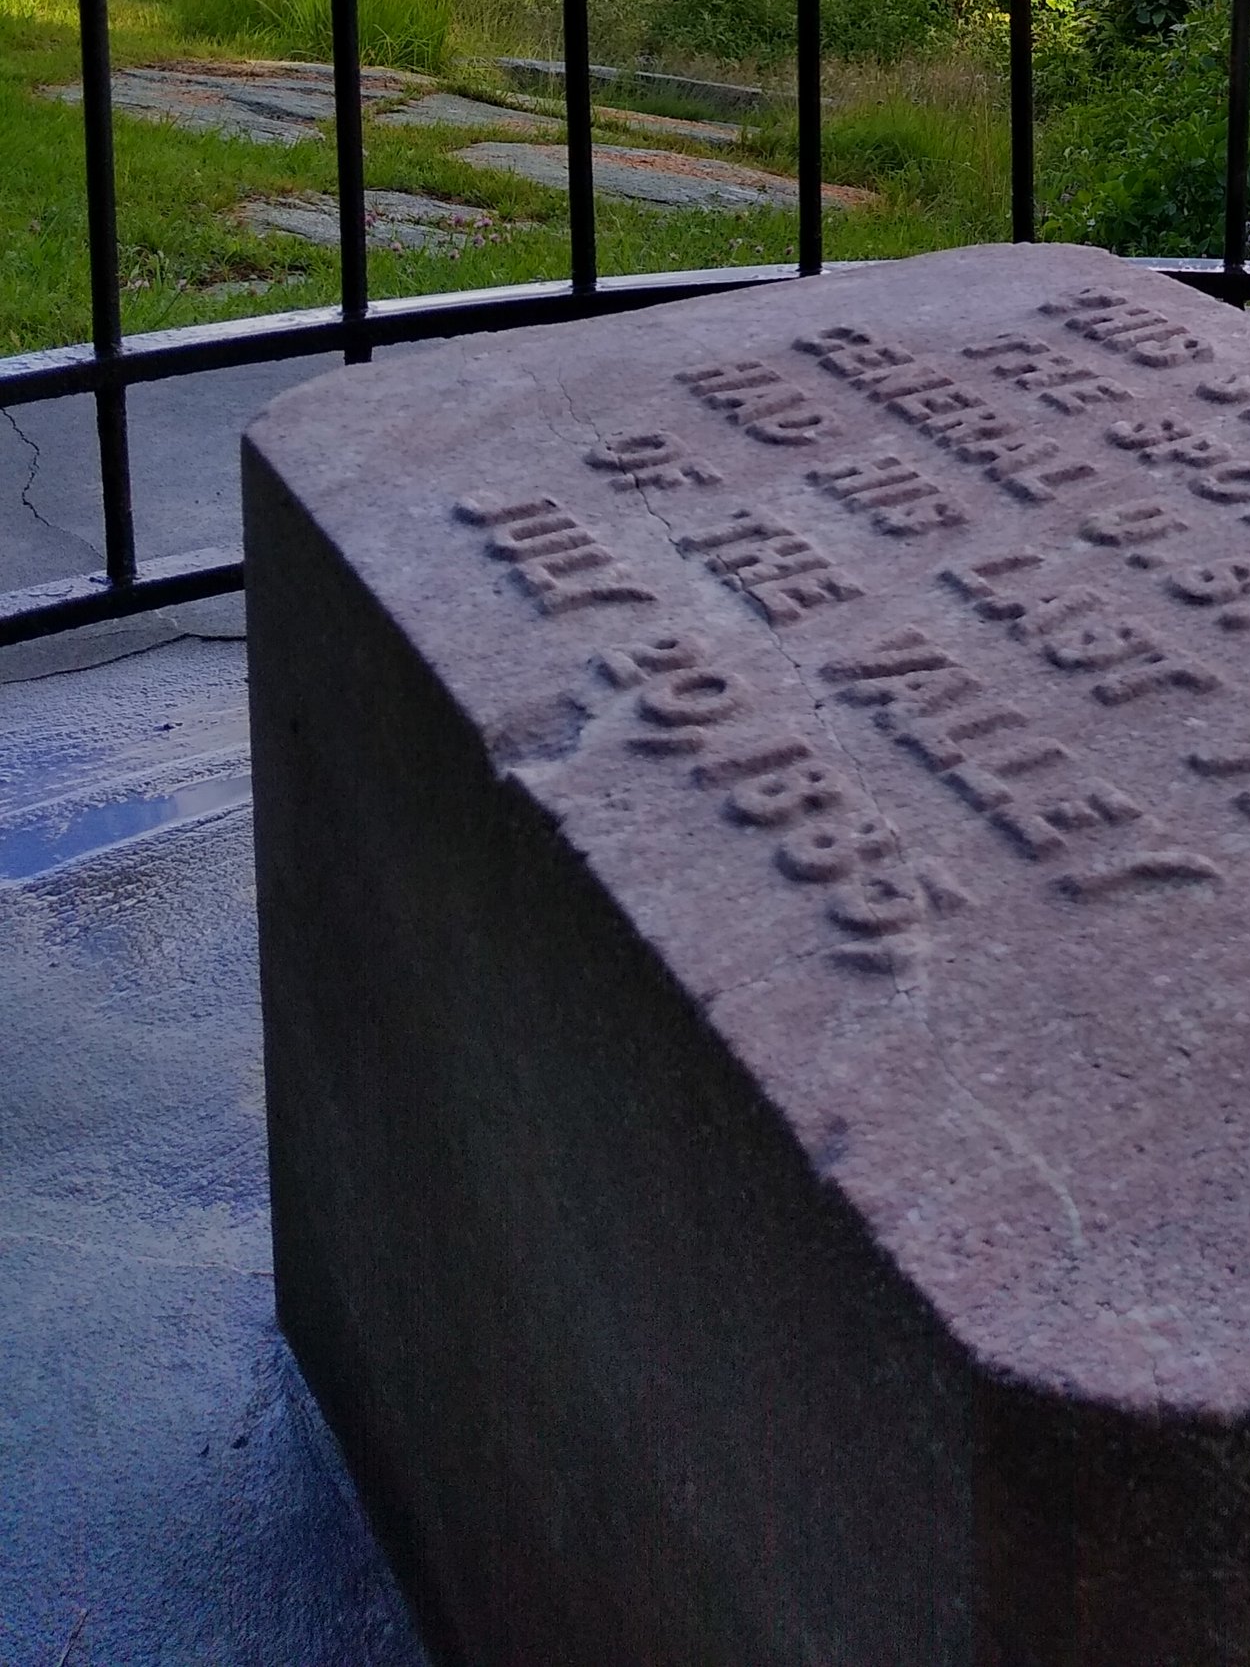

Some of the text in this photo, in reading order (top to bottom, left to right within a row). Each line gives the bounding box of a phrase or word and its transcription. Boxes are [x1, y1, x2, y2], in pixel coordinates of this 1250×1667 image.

[959, 333, 1136, 418] THE
[1036, 284, 1214, 370] THIS
[793, 324, 1098, 503] GENERAL
[452, 490, 659, 616] JULY
[673, 359, 840, 446] HAD
[804, 454, 972, 535] HIS
[937, 552, 1225, 708] LAST
[582, 430, 1224, 905] OF THE VALLEY
